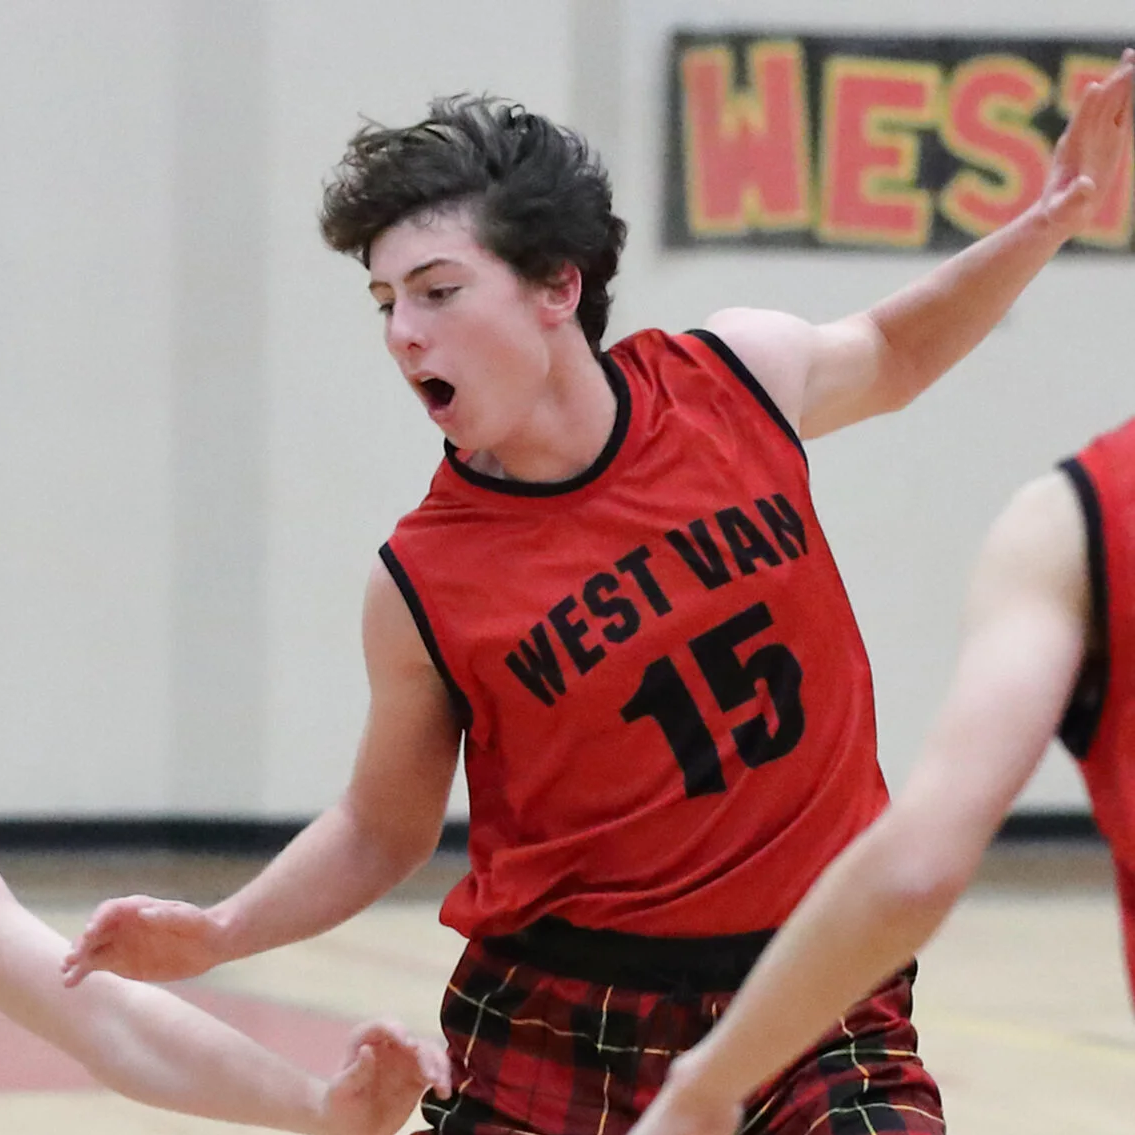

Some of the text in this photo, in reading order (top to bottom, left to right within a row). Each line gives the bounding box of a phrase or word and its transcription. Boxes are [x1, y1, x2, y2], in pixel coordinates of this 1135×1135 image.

[505, 493, 808, 707] WEST VAN
[620, 602, 805, 798] 15
